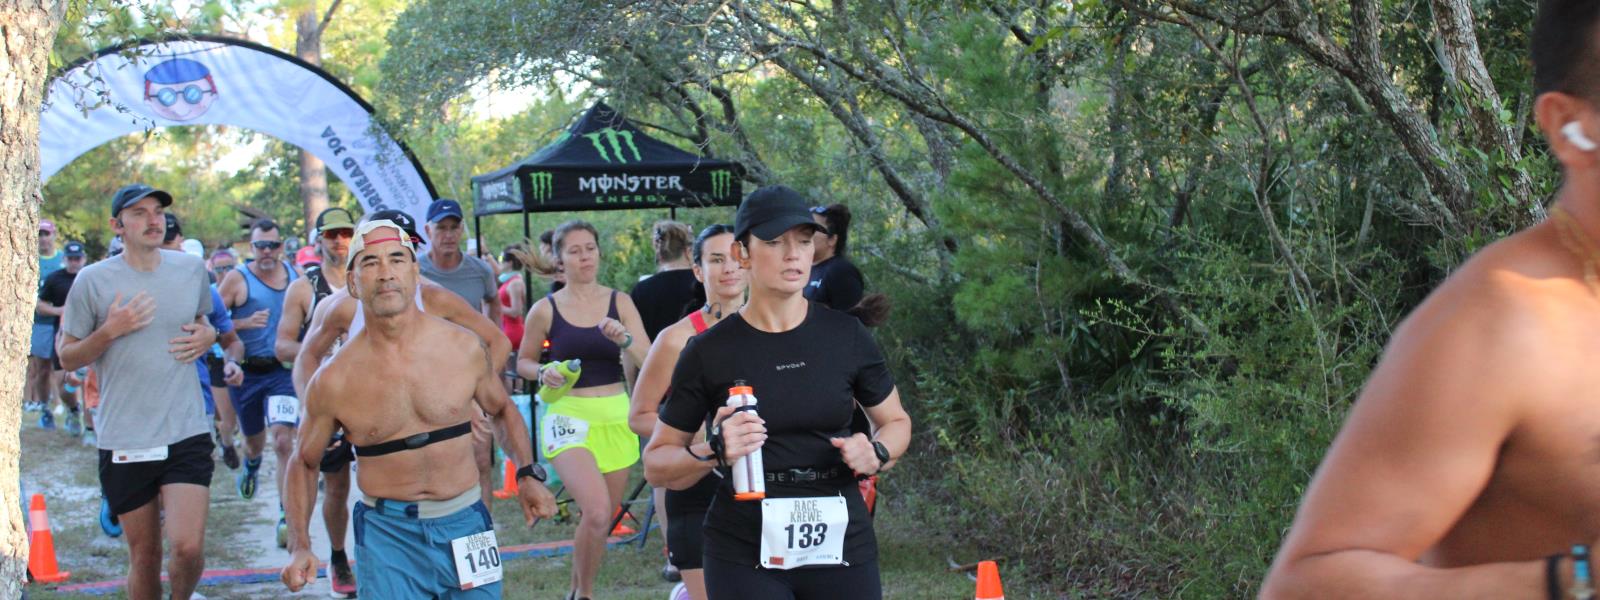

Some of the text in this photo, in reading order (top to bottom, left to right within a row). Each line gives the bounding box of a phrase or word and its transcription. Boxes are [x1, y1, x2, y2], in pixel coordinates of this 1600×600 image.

[321, 125, 347, 156] 30A
[579, 173, 684, 194] MONSTER
[595, 194, 668, 204] ENERGY
[794, 499, 818, 512] RACE
[790, 510, 823, 523] KREWE
[784, 522, 828, 549] 133
[465, 541, 492, 552] KREWE
[465, 546, 500, 573] 140
